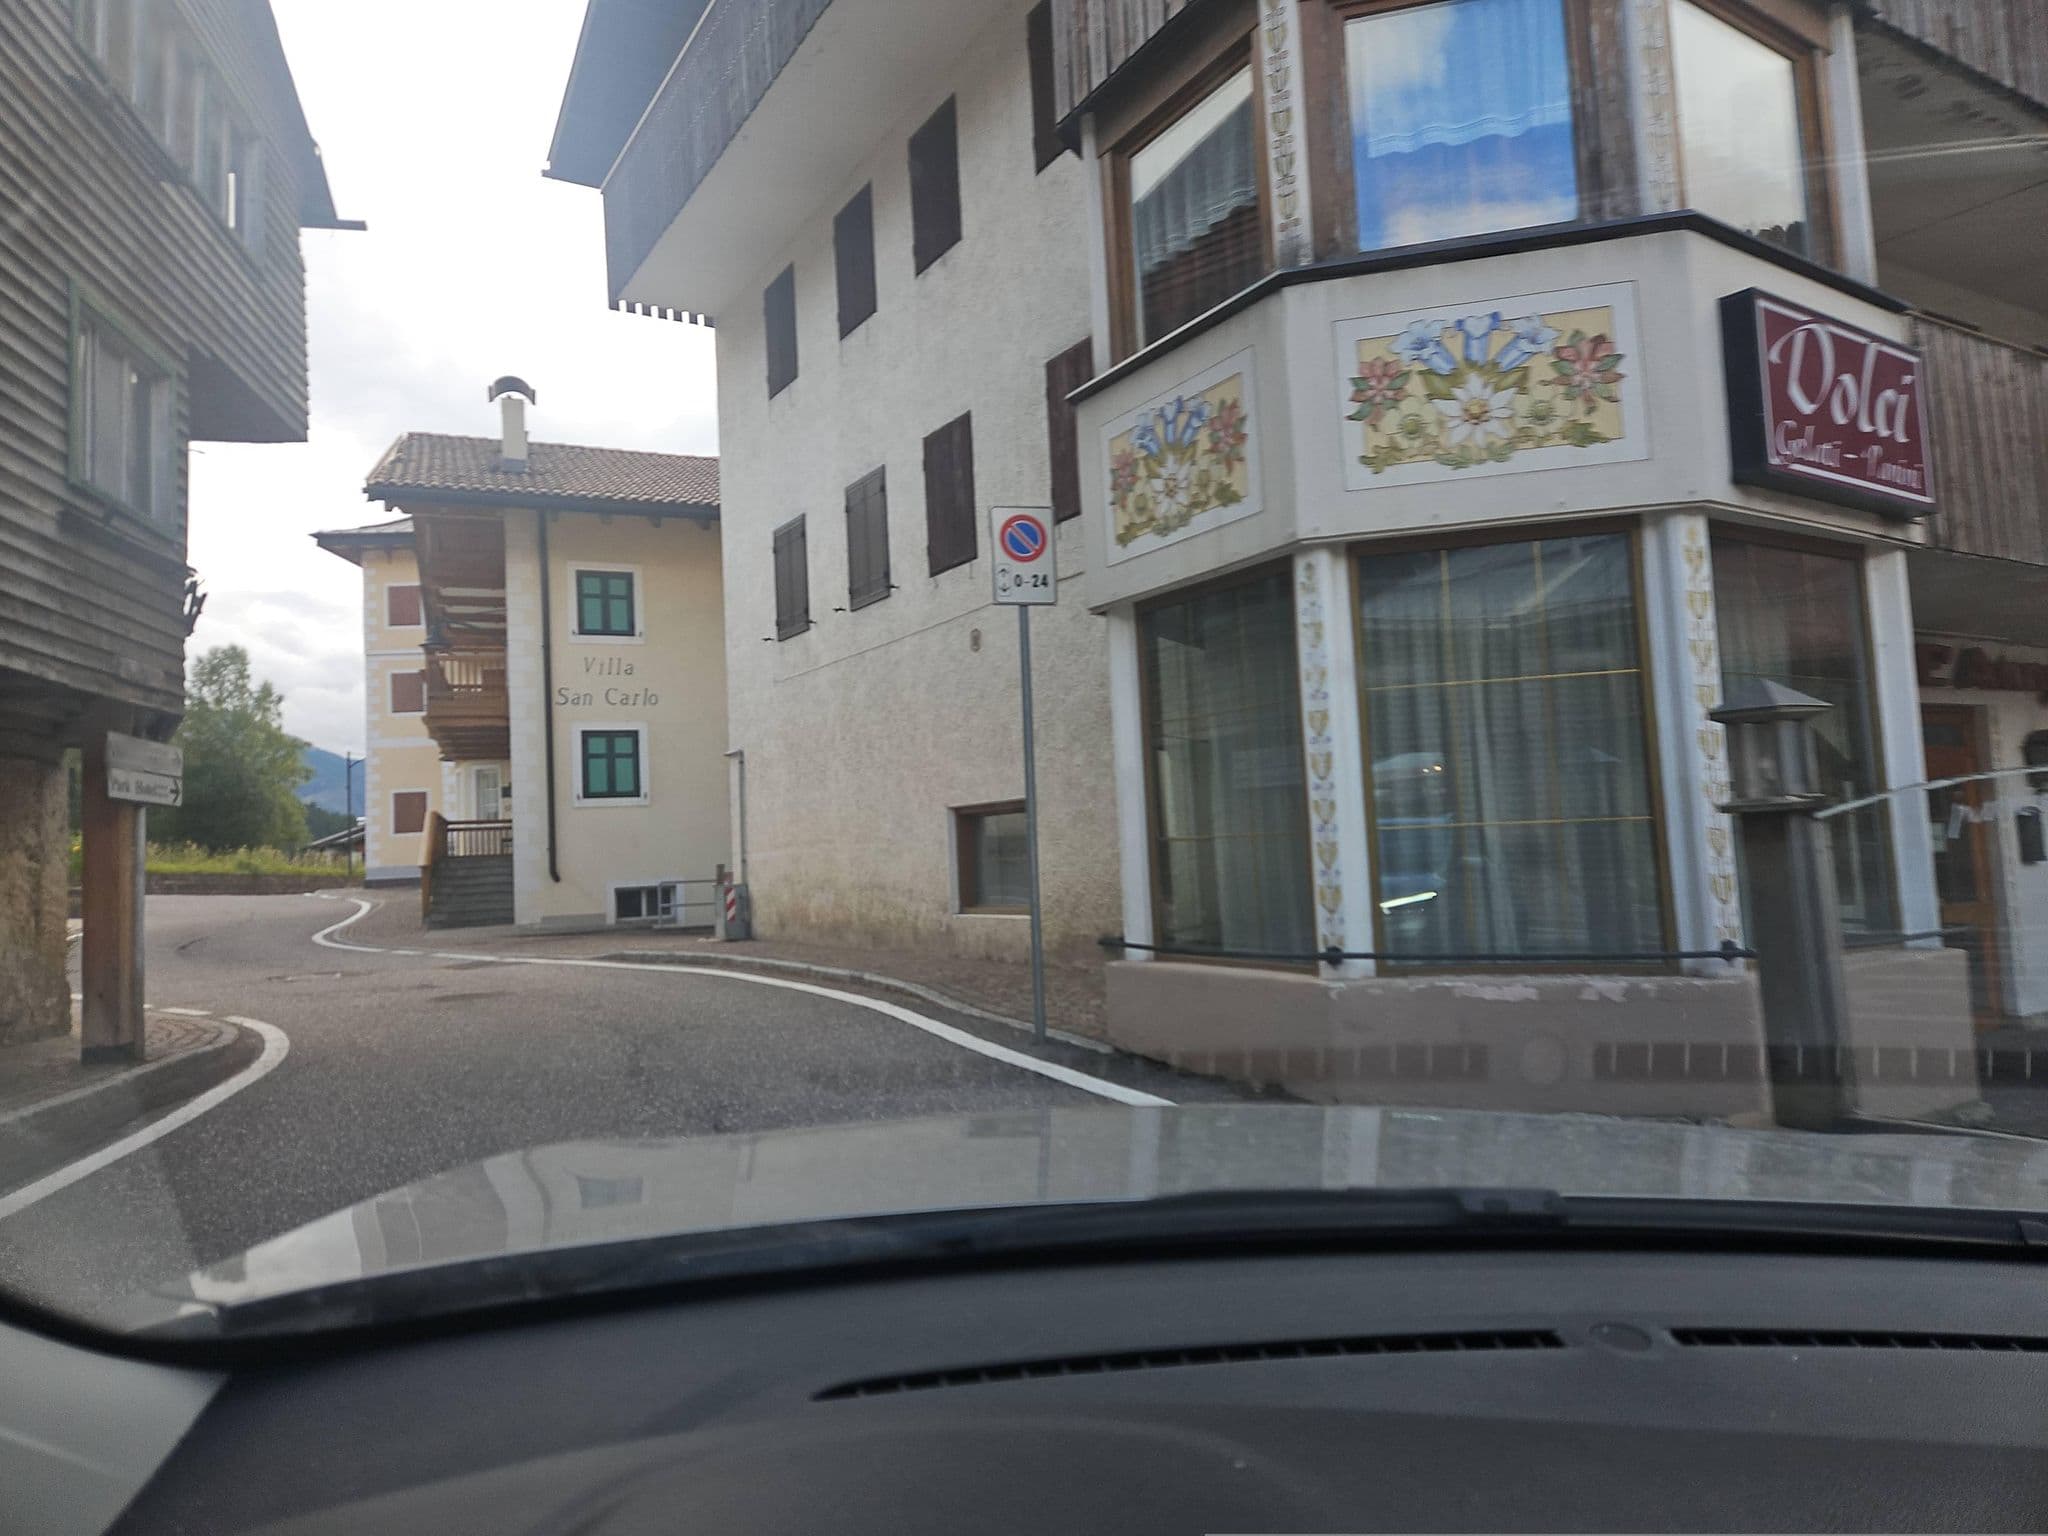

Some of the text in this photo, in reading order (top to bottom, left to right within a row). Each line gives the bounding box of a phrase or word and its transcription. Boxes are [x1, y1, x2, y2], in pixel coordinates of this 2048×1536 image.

[1769, 323, 1915, 442] Dolci
[1014, 574, 1049, 587] 0-24
[584, 657, 635, 676] Villa
[555, 687, 659, 706] San Carlo
